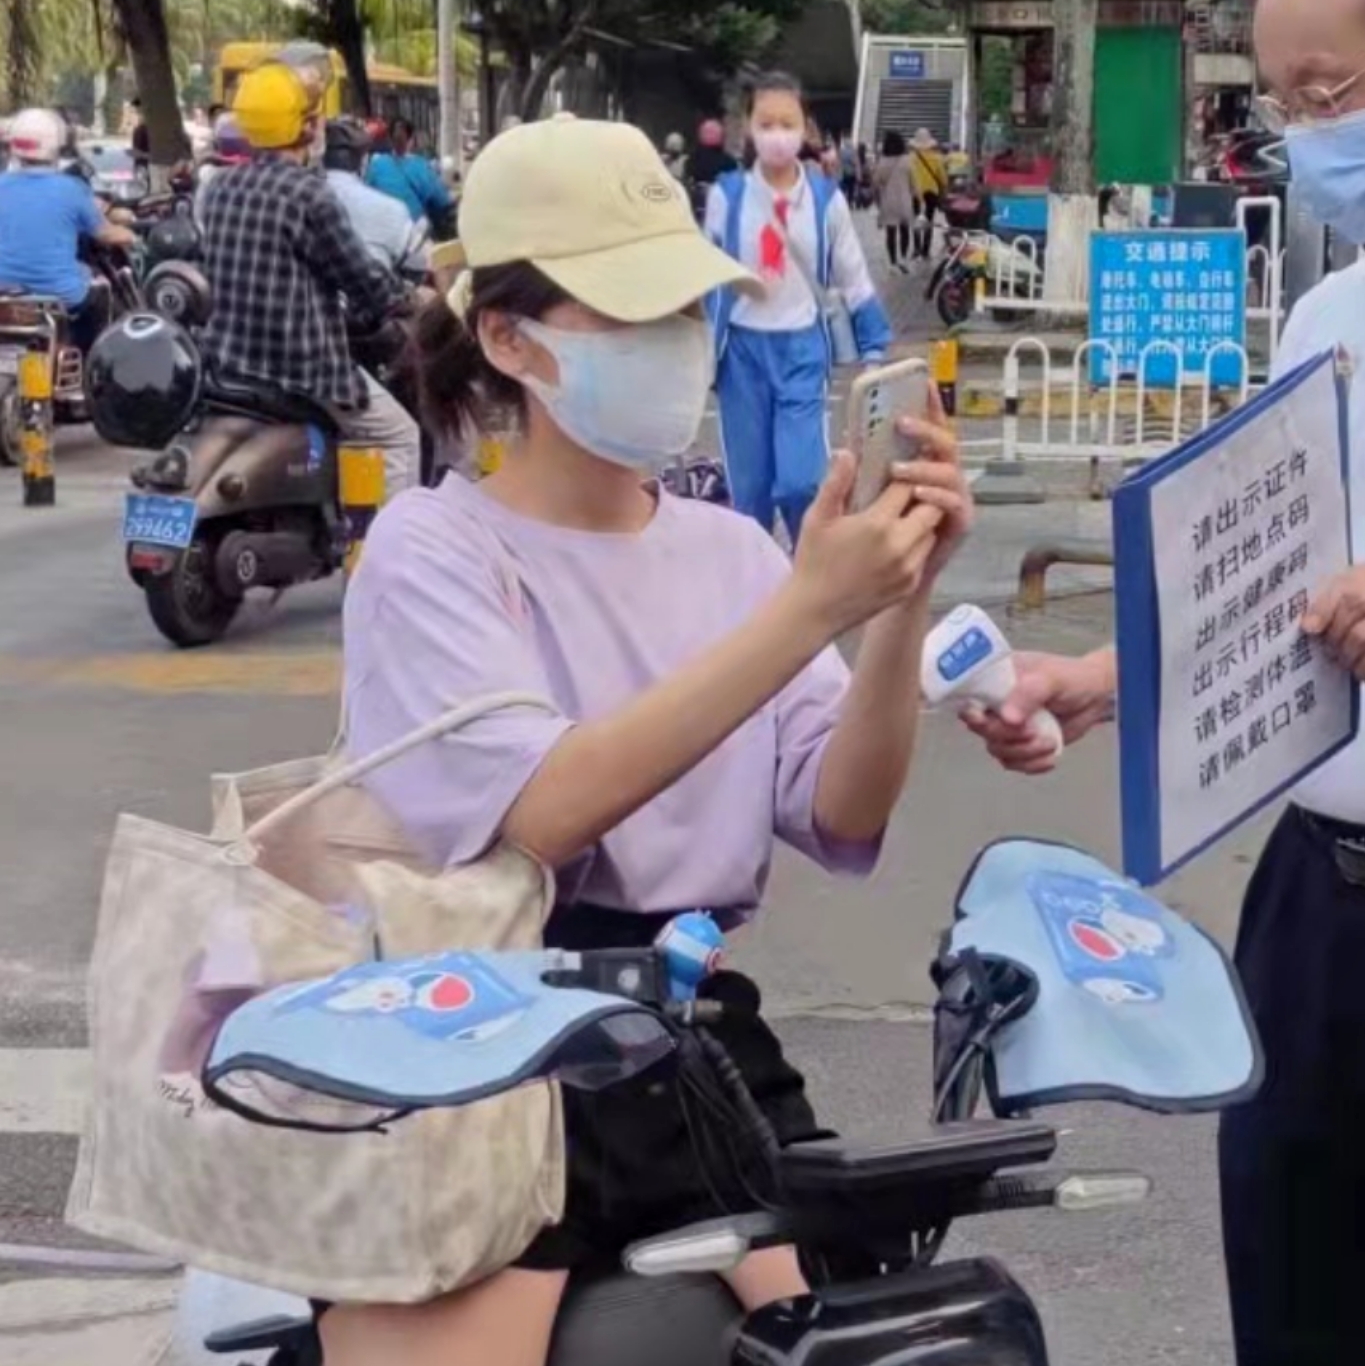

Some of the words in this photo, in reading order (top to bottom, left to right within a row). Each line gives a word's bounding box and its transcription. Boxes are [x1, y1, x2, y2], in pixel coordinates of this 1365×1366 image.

[1125, 240, 1212, 263] 交通提示
[1191, 449, 1308, 553] 请出示证件
[1193, 493, 1310, 602] 请扫地点码
[1191, 587, 1309, 697] 出示行程码
[1194, 541, 1308, 653] 出示健康码
[1193, 634, 1314, 744] 请检测体温
[1198, 679, 1316, 789] 请佩戴口罩
